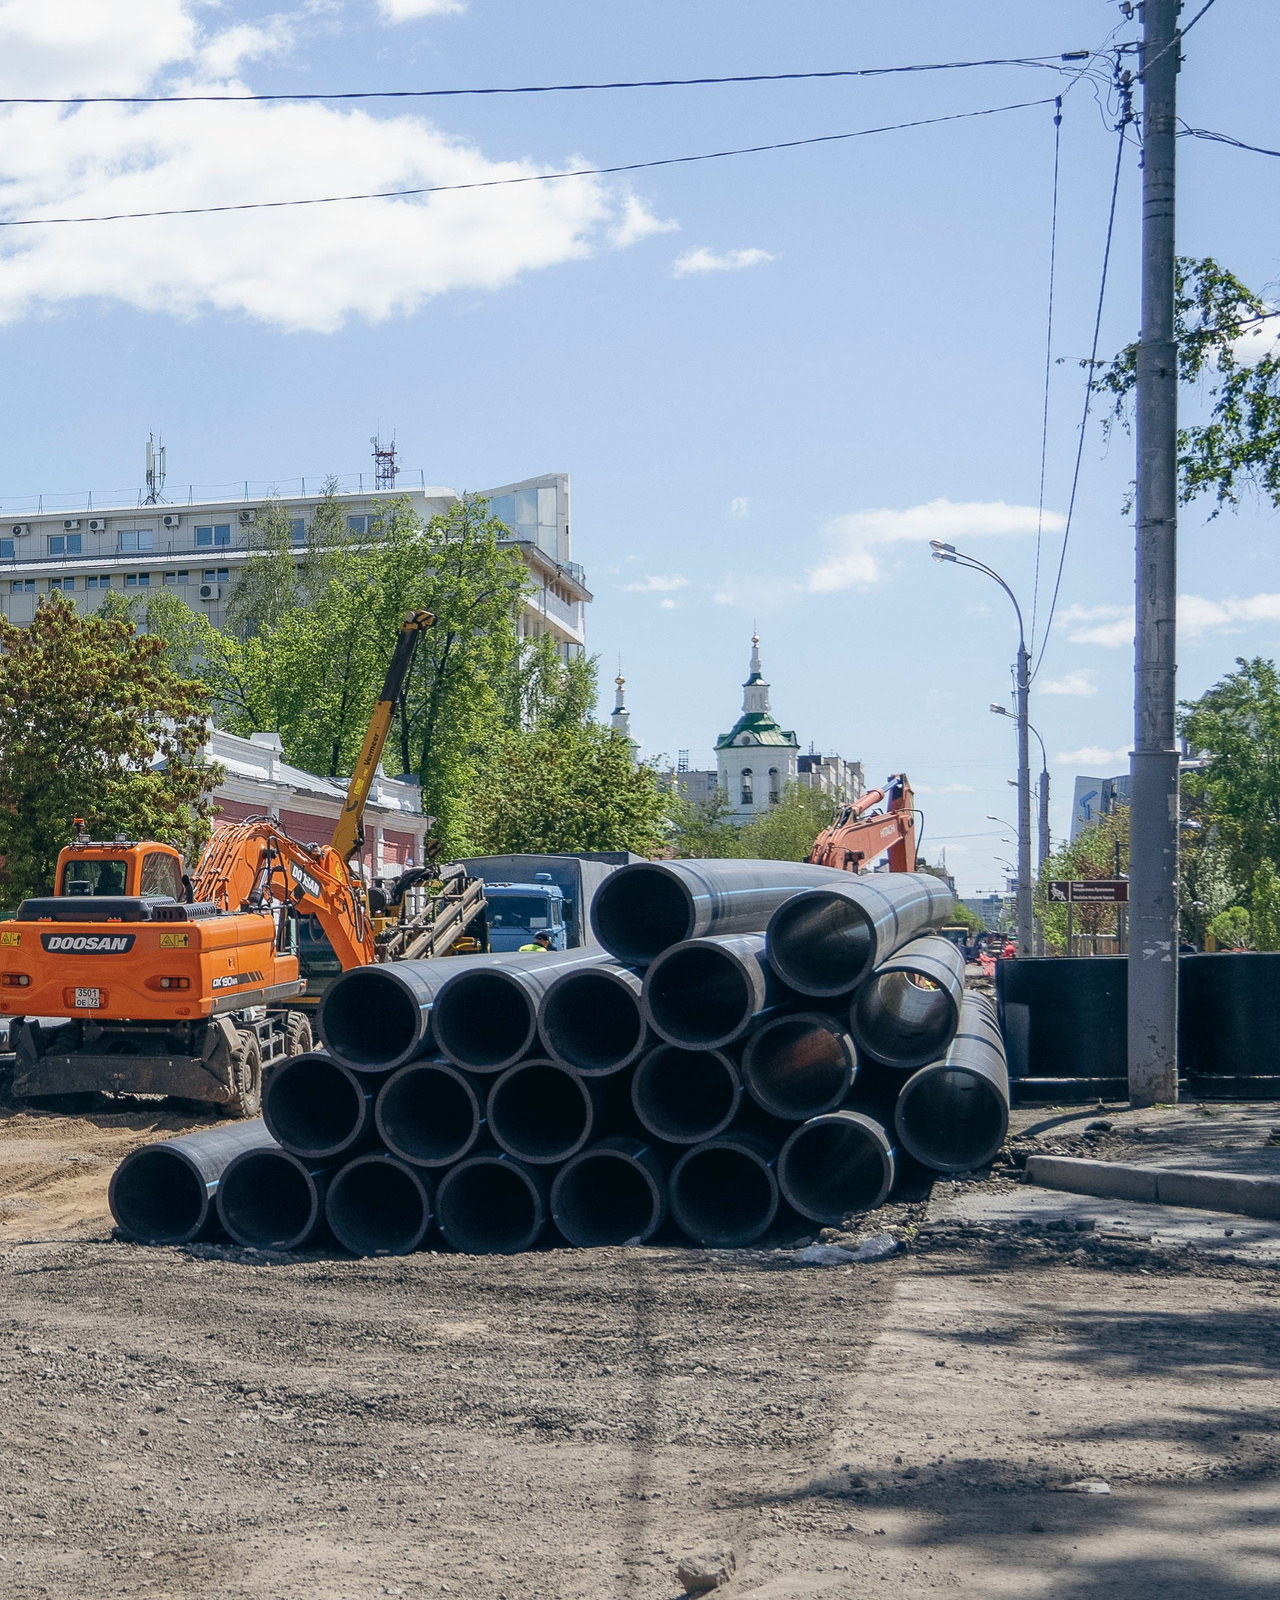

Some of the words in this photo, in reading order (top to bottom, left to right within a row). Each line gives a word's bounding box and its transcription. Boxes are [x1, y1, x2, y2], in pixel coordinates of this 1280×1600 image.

[364, 733, 379, 765] Vermeer
[47, 936, 128, 951] DOOSAN
[77, 988, 97, 998] 3501
